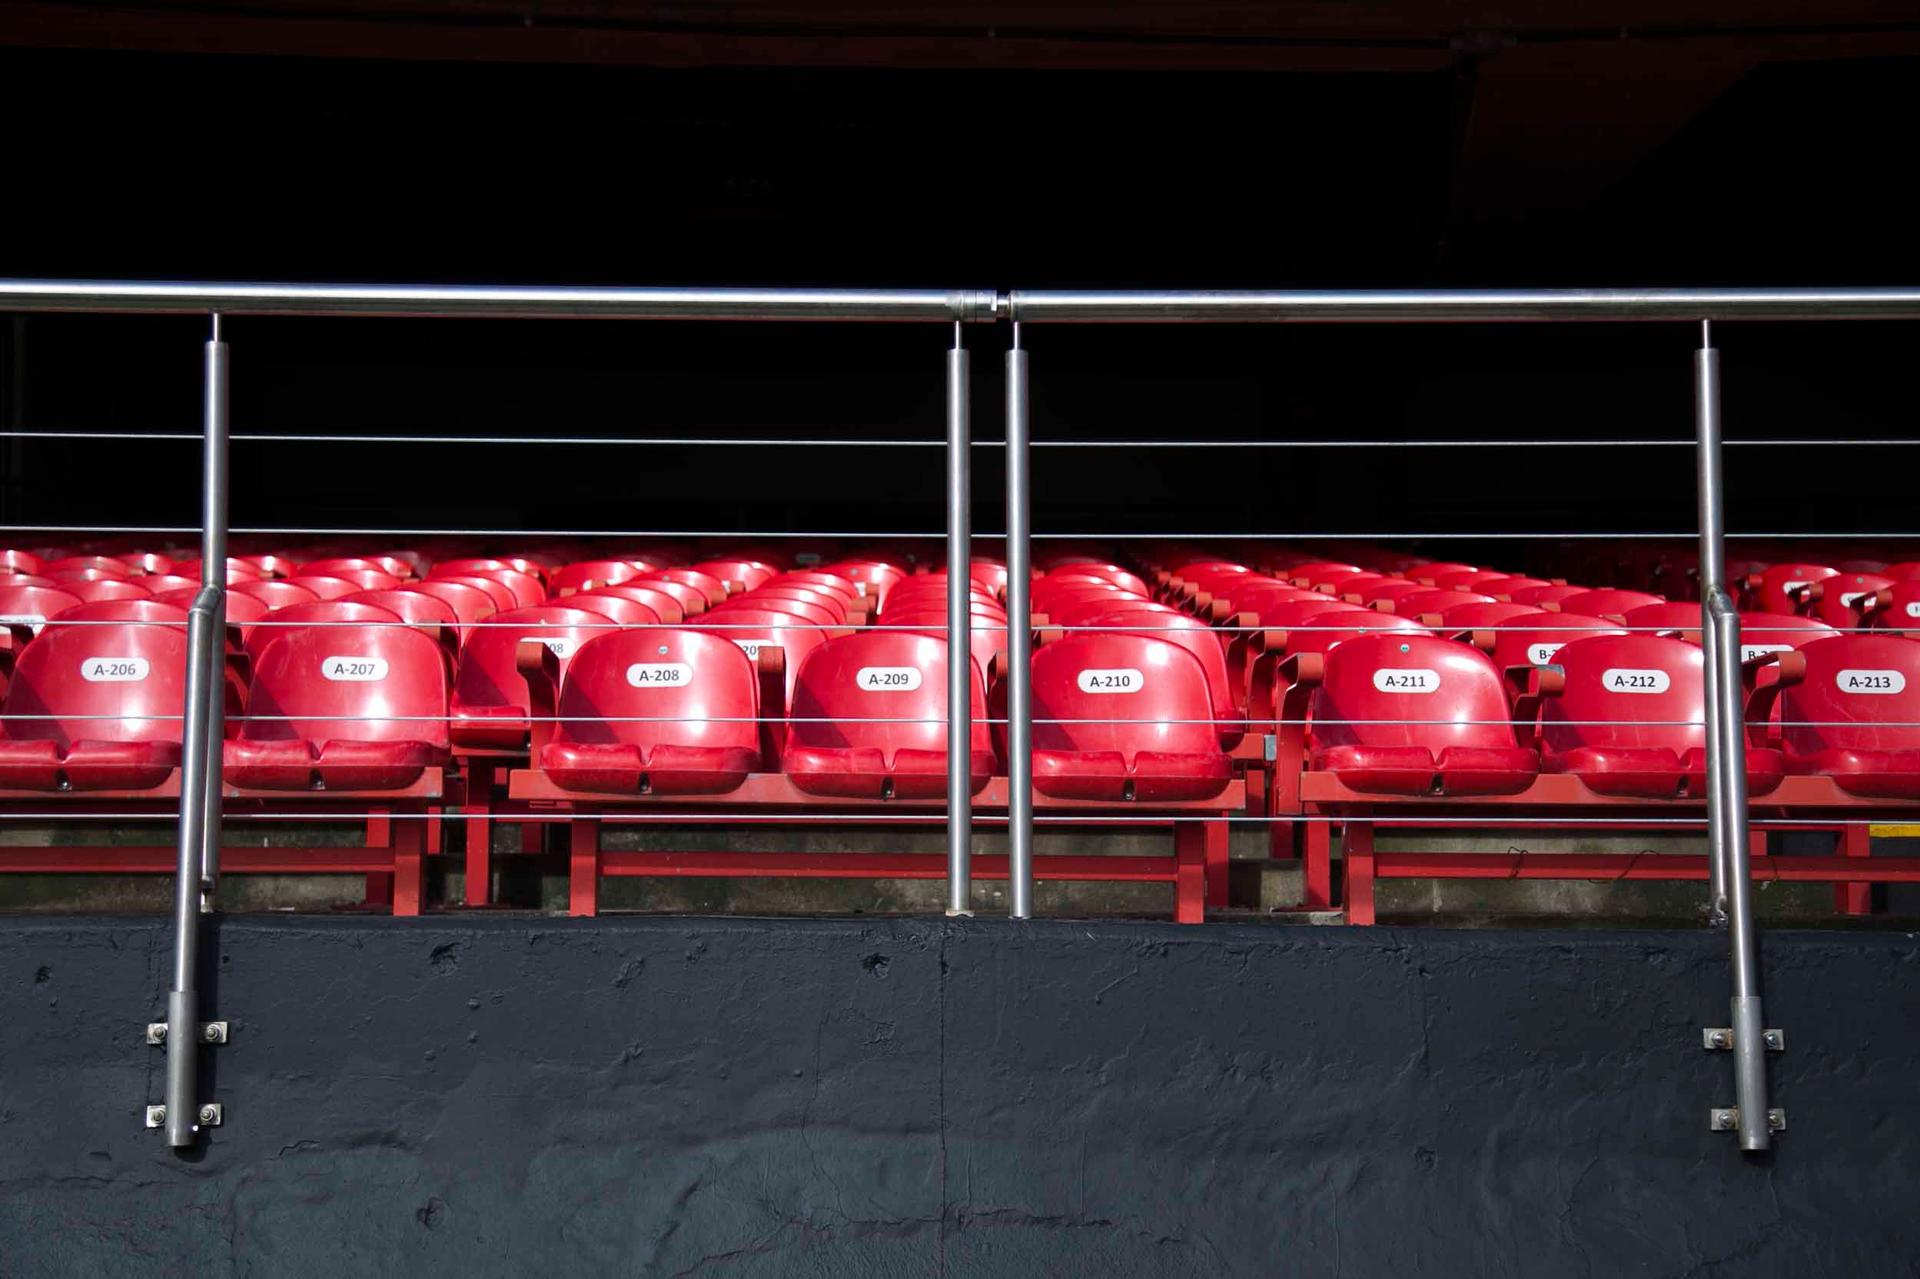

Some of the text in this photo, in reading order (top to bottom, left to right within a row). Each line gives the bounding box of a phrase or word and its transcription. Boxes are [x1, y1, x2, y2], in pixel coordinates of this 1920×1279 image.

[94, 664, 136, 676] A-206
[334, 663, 376, 675] A-207
[639, 670, 680, 682] A-208
[869, 673, 909, 685] A-209
[1090, 675, 1131, 687] A-210
[1385, 675, 1426, 688] A-211
[1614, 675, 1656, 688] A-212
[1848, 676, 1892, 689] A-213
